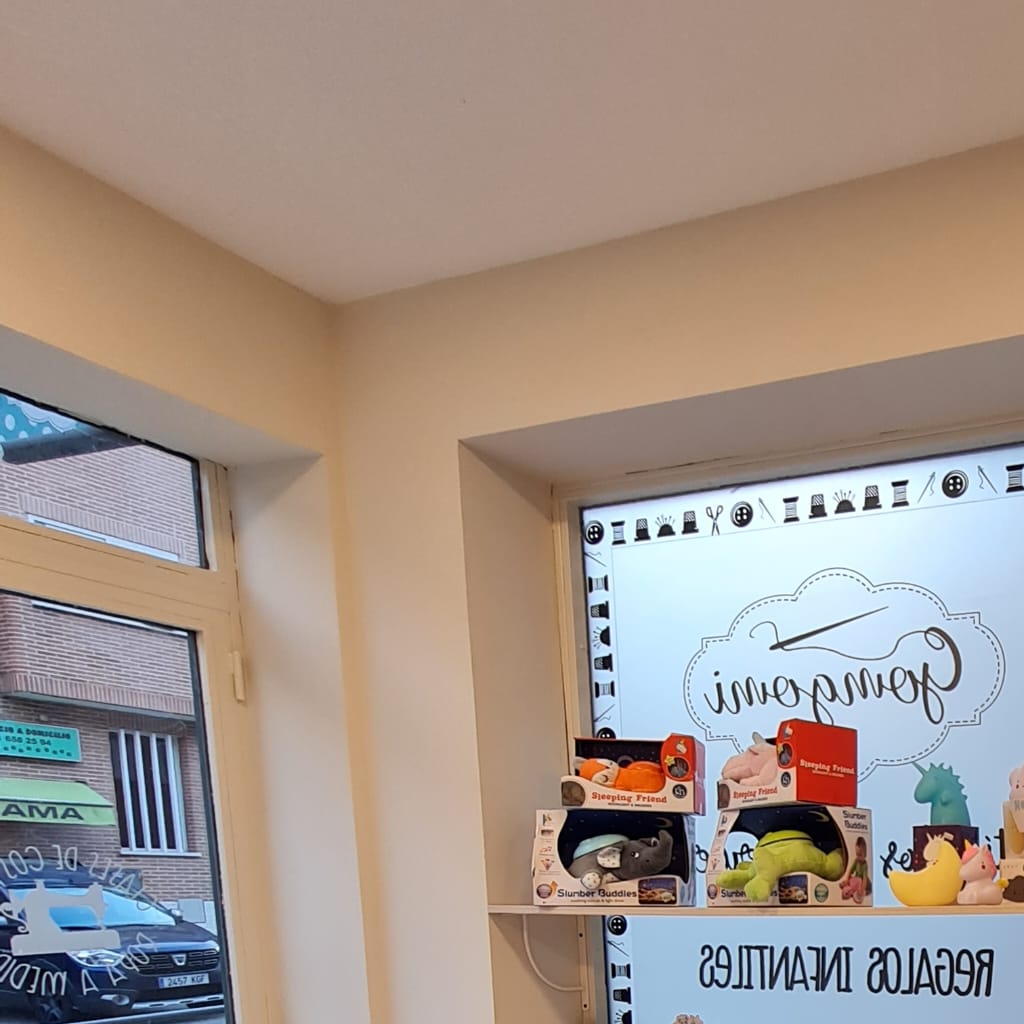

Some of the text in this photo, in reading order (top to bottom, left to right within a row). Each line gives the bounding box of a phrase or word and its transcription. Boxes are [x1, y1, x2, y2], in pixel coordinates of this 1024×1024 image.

[591, 791, 667, 804] Sleeping Friend
[557, 888, 637, 898] Slumber Buddies
[720, 888, 747, 898] Slumb
